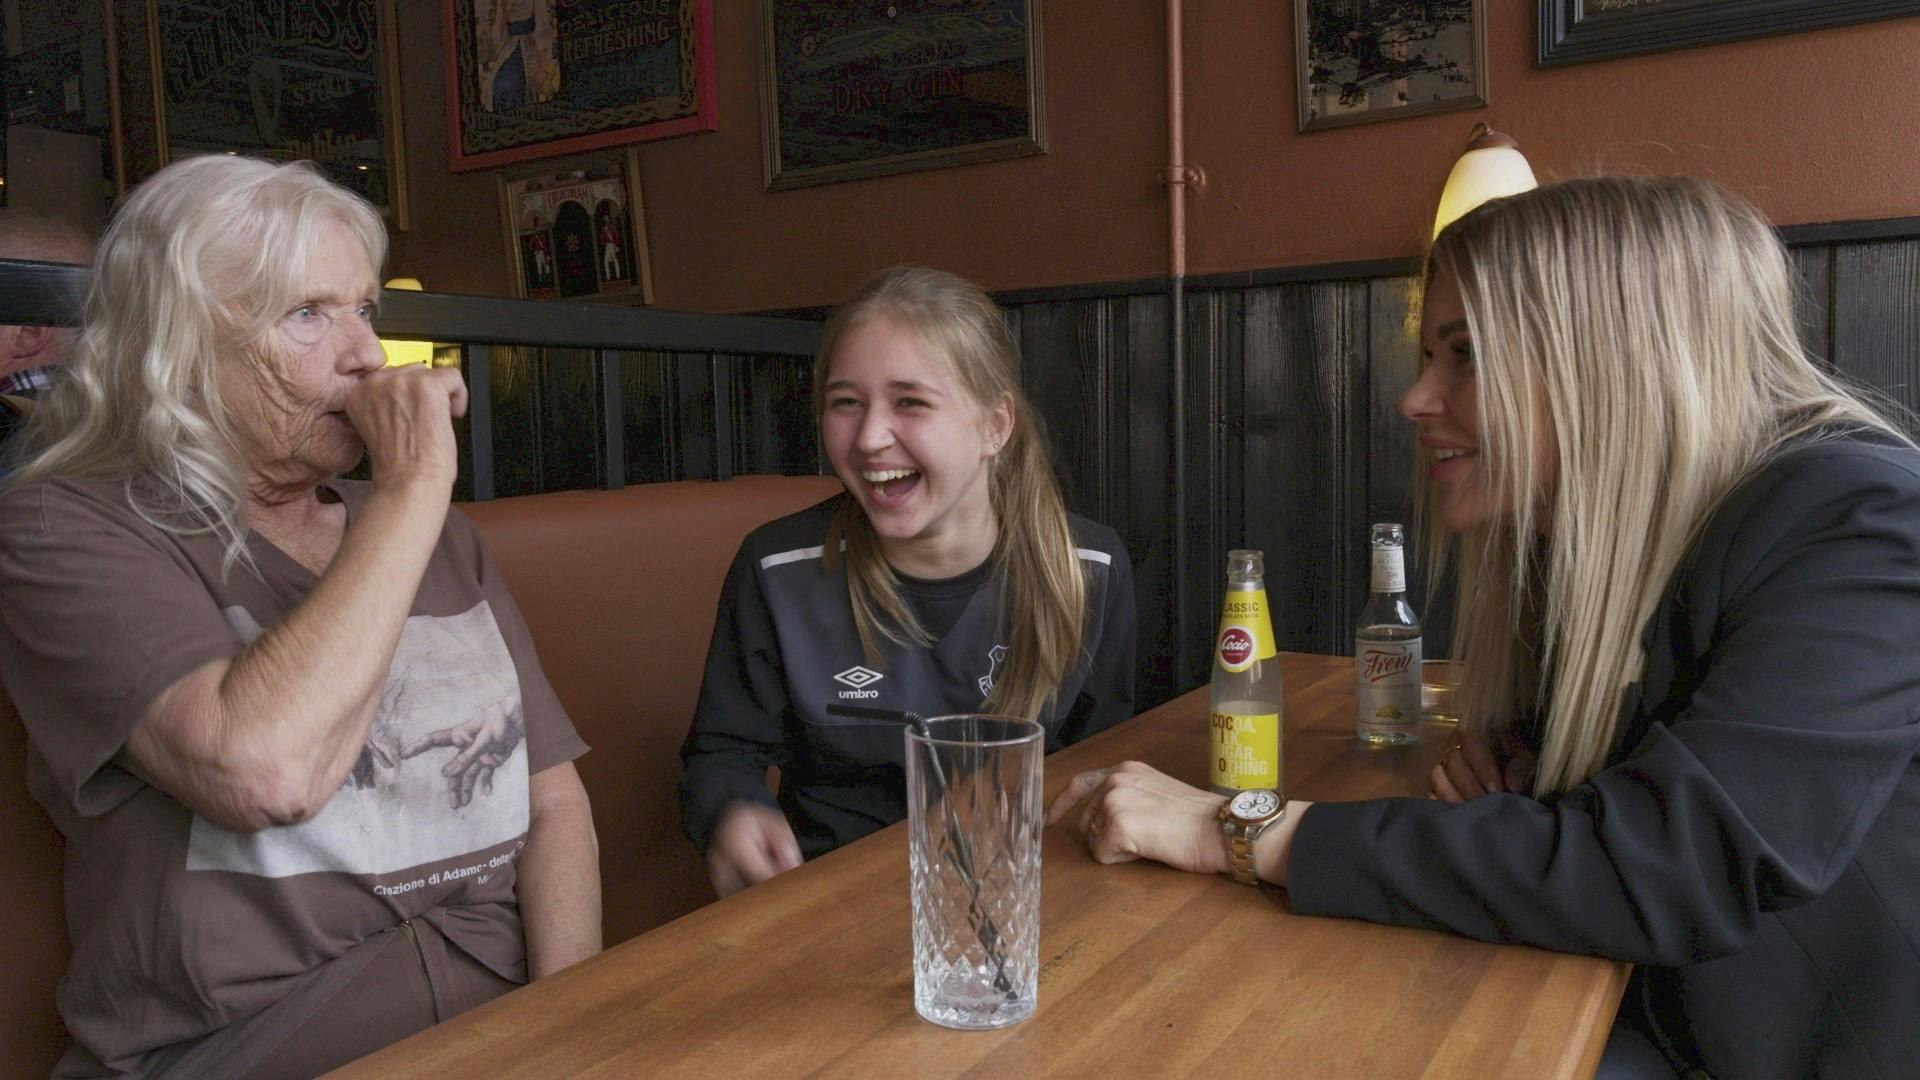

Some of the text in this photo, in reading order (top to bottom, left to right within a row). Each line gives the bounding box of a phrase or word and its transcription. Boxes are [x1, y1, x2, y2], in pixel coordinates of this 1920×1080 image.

[832, 64, 966, 114] DRY GIN
[838, 688, 880, 700] umbro
[428, 872, 441, 886] di
